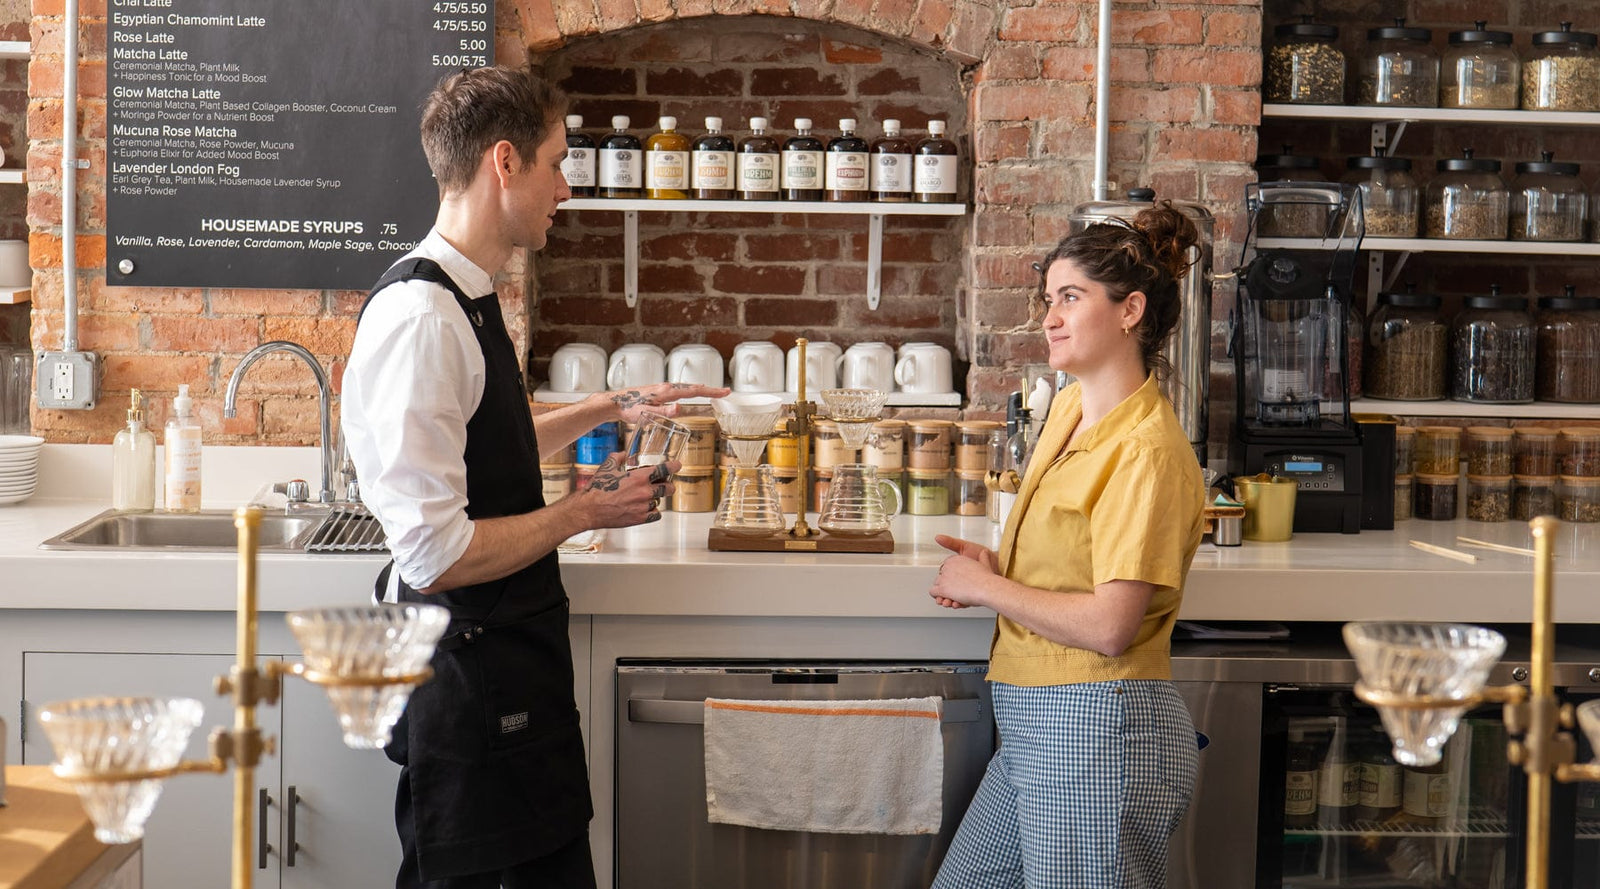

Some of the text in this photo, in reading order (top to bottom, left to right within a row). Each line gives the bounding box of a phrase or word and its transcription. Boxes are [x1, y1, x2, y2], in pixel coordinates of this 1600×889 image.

[433, 2, 486, 13] 4.75/5.50
[114, 13, 265, 26] Egyptian Chamomint Latte
[433, 20, 486, 31] 4.75/5.50
[114, 31, 174, 43] Rose Latte
[460, 40, 486, 50] 5.00
[114, 48, 188, 60] Matcha Latte
[432, 55, 486, 66] 5.00/5.75
[113, 61, 239, 73] Ceremonial Matcha, Plant Milk
[121, 72, 166, 82] Happiness
[169, 72, 192, 81] Tonic
[194, 73, 205, 81] for
[215, 73, 239, 82] Mood
[242, 74, 267, 82] Boost
[113, 86, 220, 99] Glow Matcha Latte
[113, 99, 396, 113] Ceremonial Matcha, Plant Based Collagen Booster, Coconut Cream
[121, 110, 155, 121] Moringa
[158, 111, 190, 120] Powder
[193, 112, 204, 120] for
[214, 112, 247, 121] Nutrient
[250, 112, 274, 121] Boost
[114, 125, 236, 137] Mucuna Rose Matcha
[113, 137, 294, 151] Ceremonial Matcha, Rose Powder, Mucuna
[121, 148, 158, 158] Euphoria
[161, 149, 180, 158] Elixir
[183, 149, 194, 158] for
[196, 150, 225, 158] Added
[228, 150, 252, 159] Mood
[255, 151, 279, 160] Boost
[114, 162, 239, 178] Lavender London Fog
[113, 174, 341, 189] Earl Grey Tea, Plant Milk, Housemade Lavender Syrup
[121, 186, 142, 194] Rose
[145, 186, 177, 195] Powder
[202, 219, 397, 234] HOUSEMADE SYRUPS .75
[116, 236, 153, 247] Vanilla,
[157, 236, 185, 247] Rose,
[189, 237, 240, 248] Lavender,
[244, 238, 304, 249] Cardamom,
[308, 239, 341, 251] Maple
[345, 240, 374, 251] Sage,
